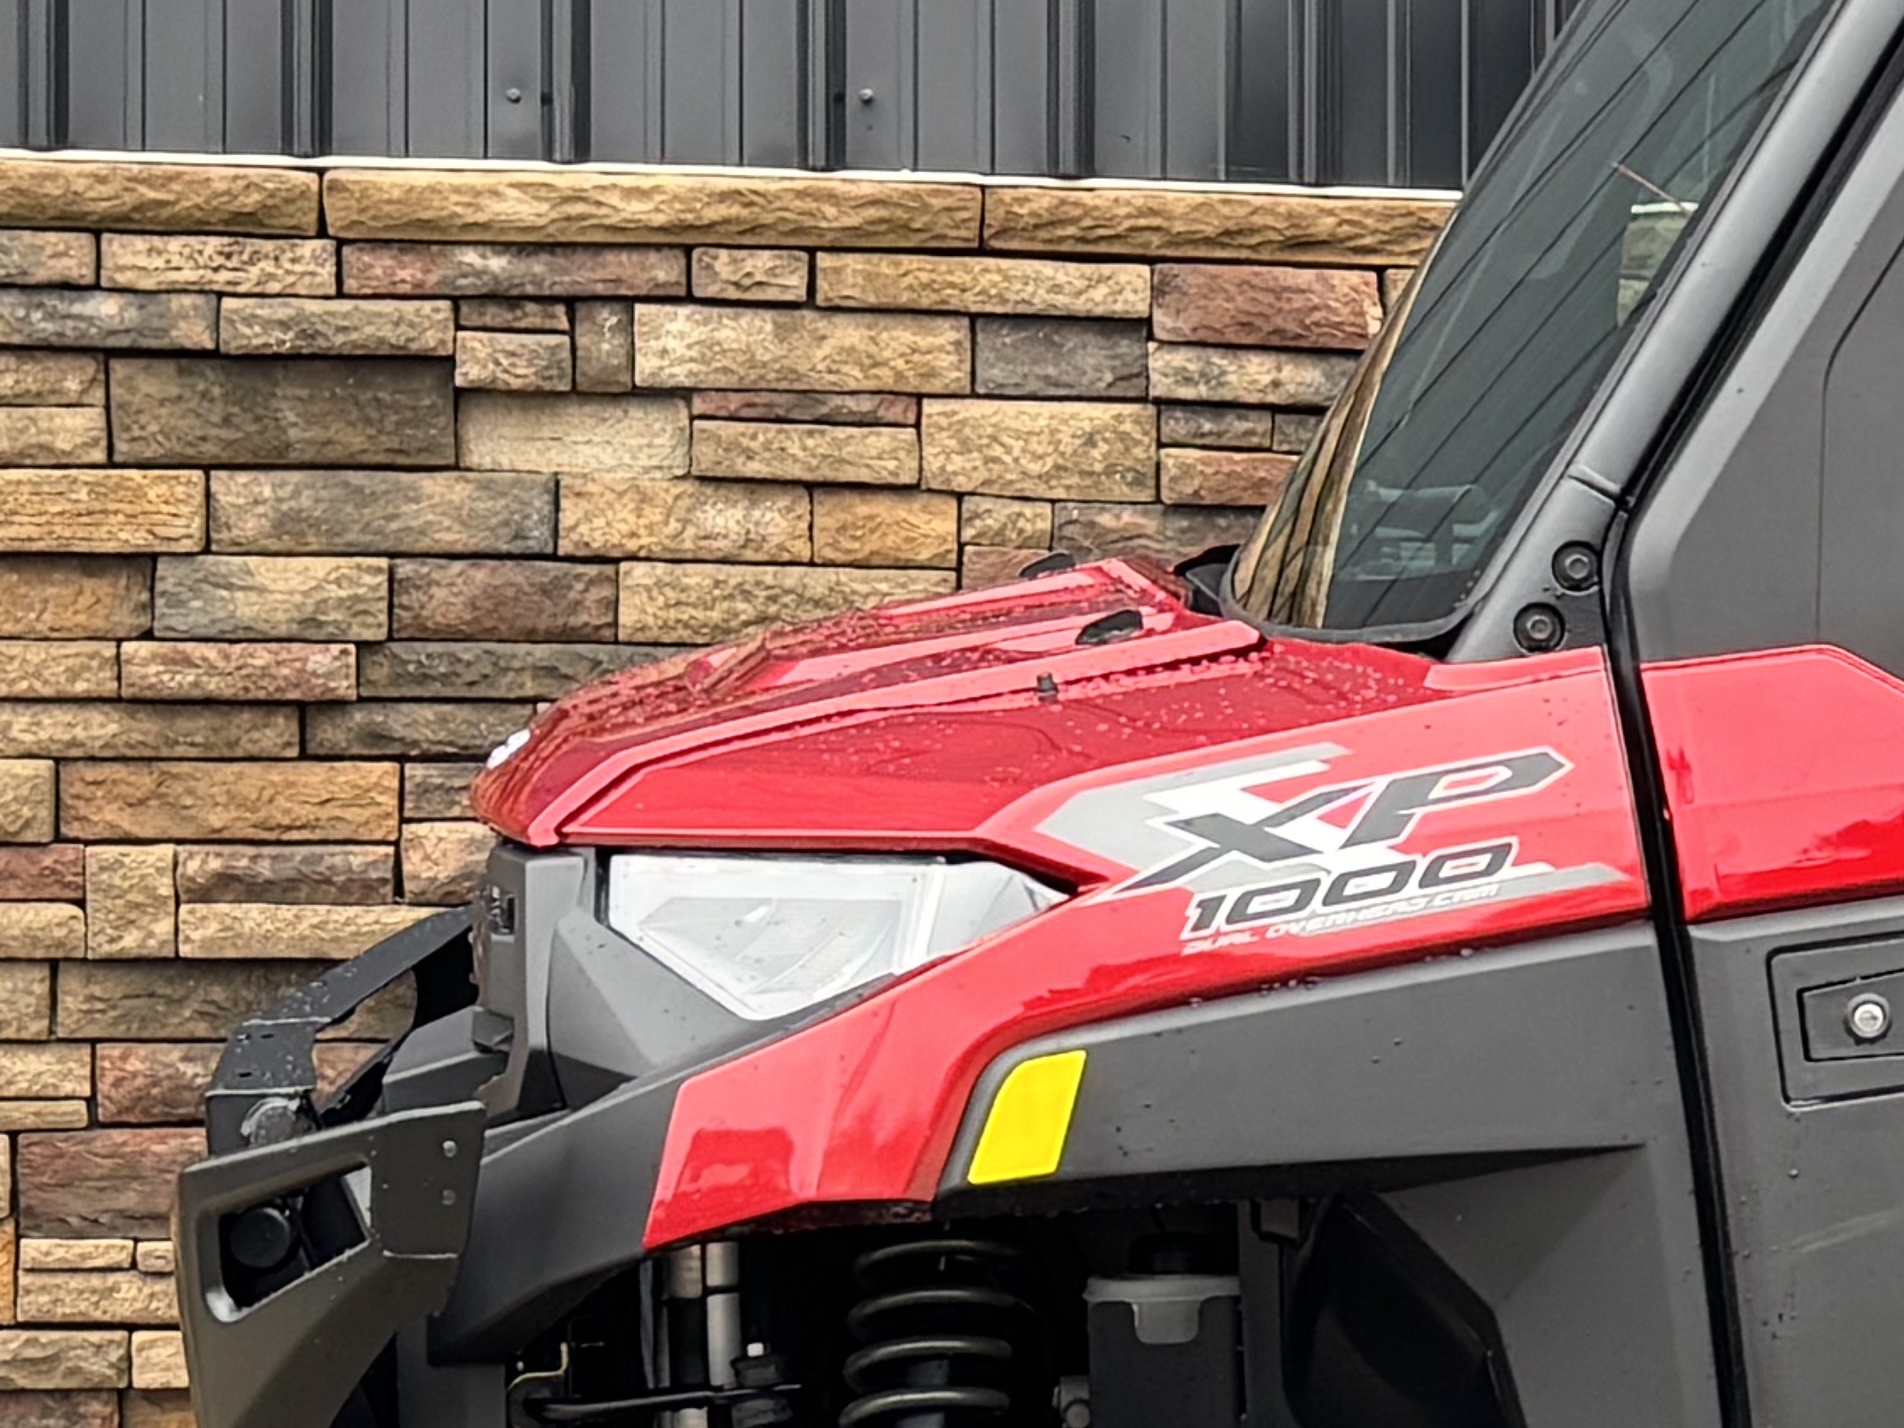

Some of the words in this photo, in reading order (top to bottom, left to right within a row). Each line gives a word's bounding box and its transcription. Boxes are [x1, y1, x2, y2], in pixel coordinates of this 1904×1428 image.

[1120, 748, 1570, 892] XP
[1181, 930, 1260, 956] DUAL
[1266, 896, 1431, 939] OVERHEAD
[1182, 839, 1517, 940] 1000
